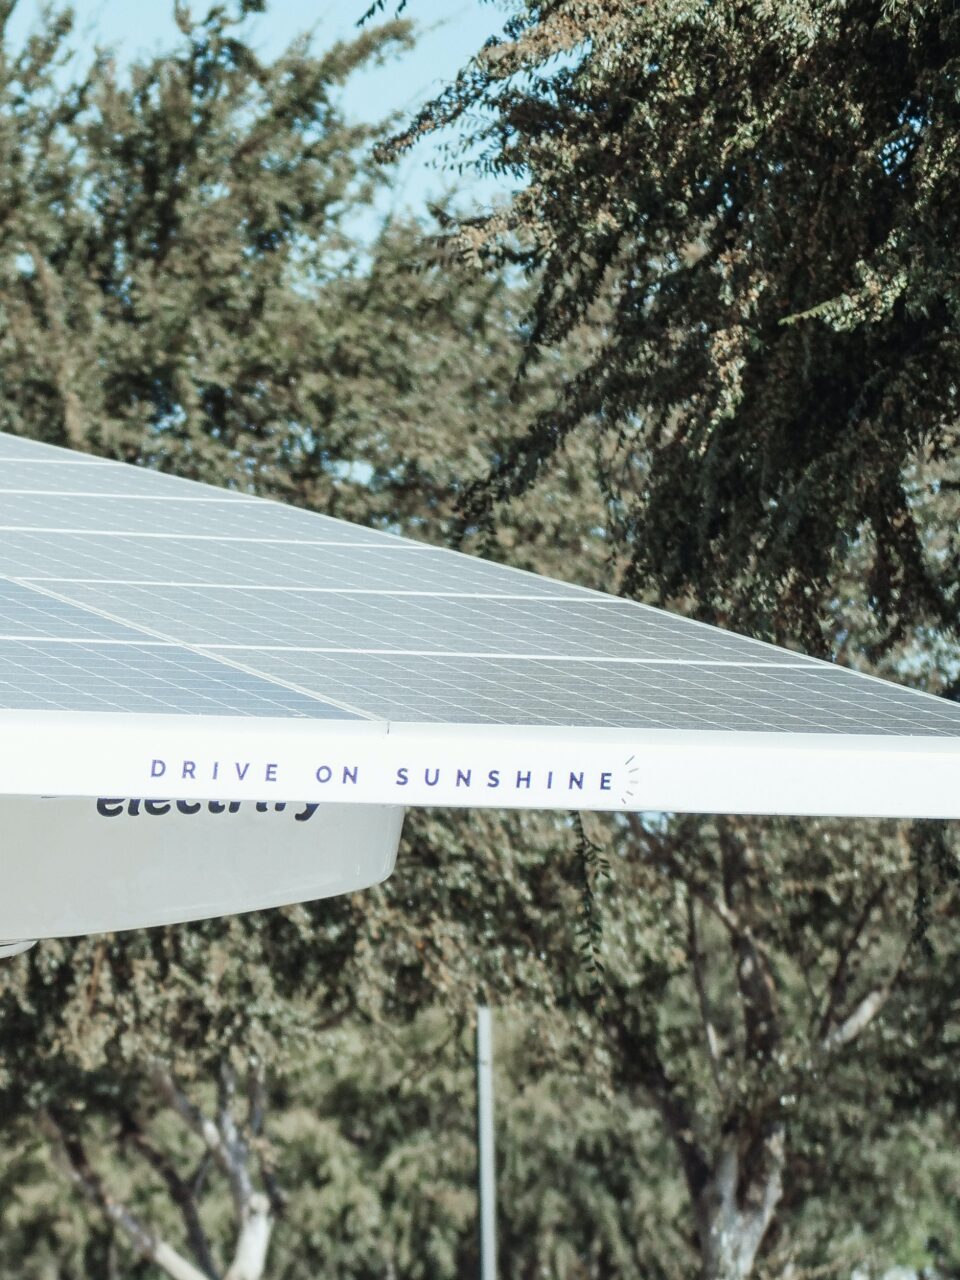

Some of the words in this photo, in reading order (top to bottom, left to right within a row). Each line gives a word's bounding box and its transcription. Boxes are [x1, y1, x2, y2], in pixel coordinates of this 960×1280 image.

[150, 758, 279, 783] DRIVE
[315, 765, 359, 785] ON
[395, 767, 613, 791] SUNSHINE
